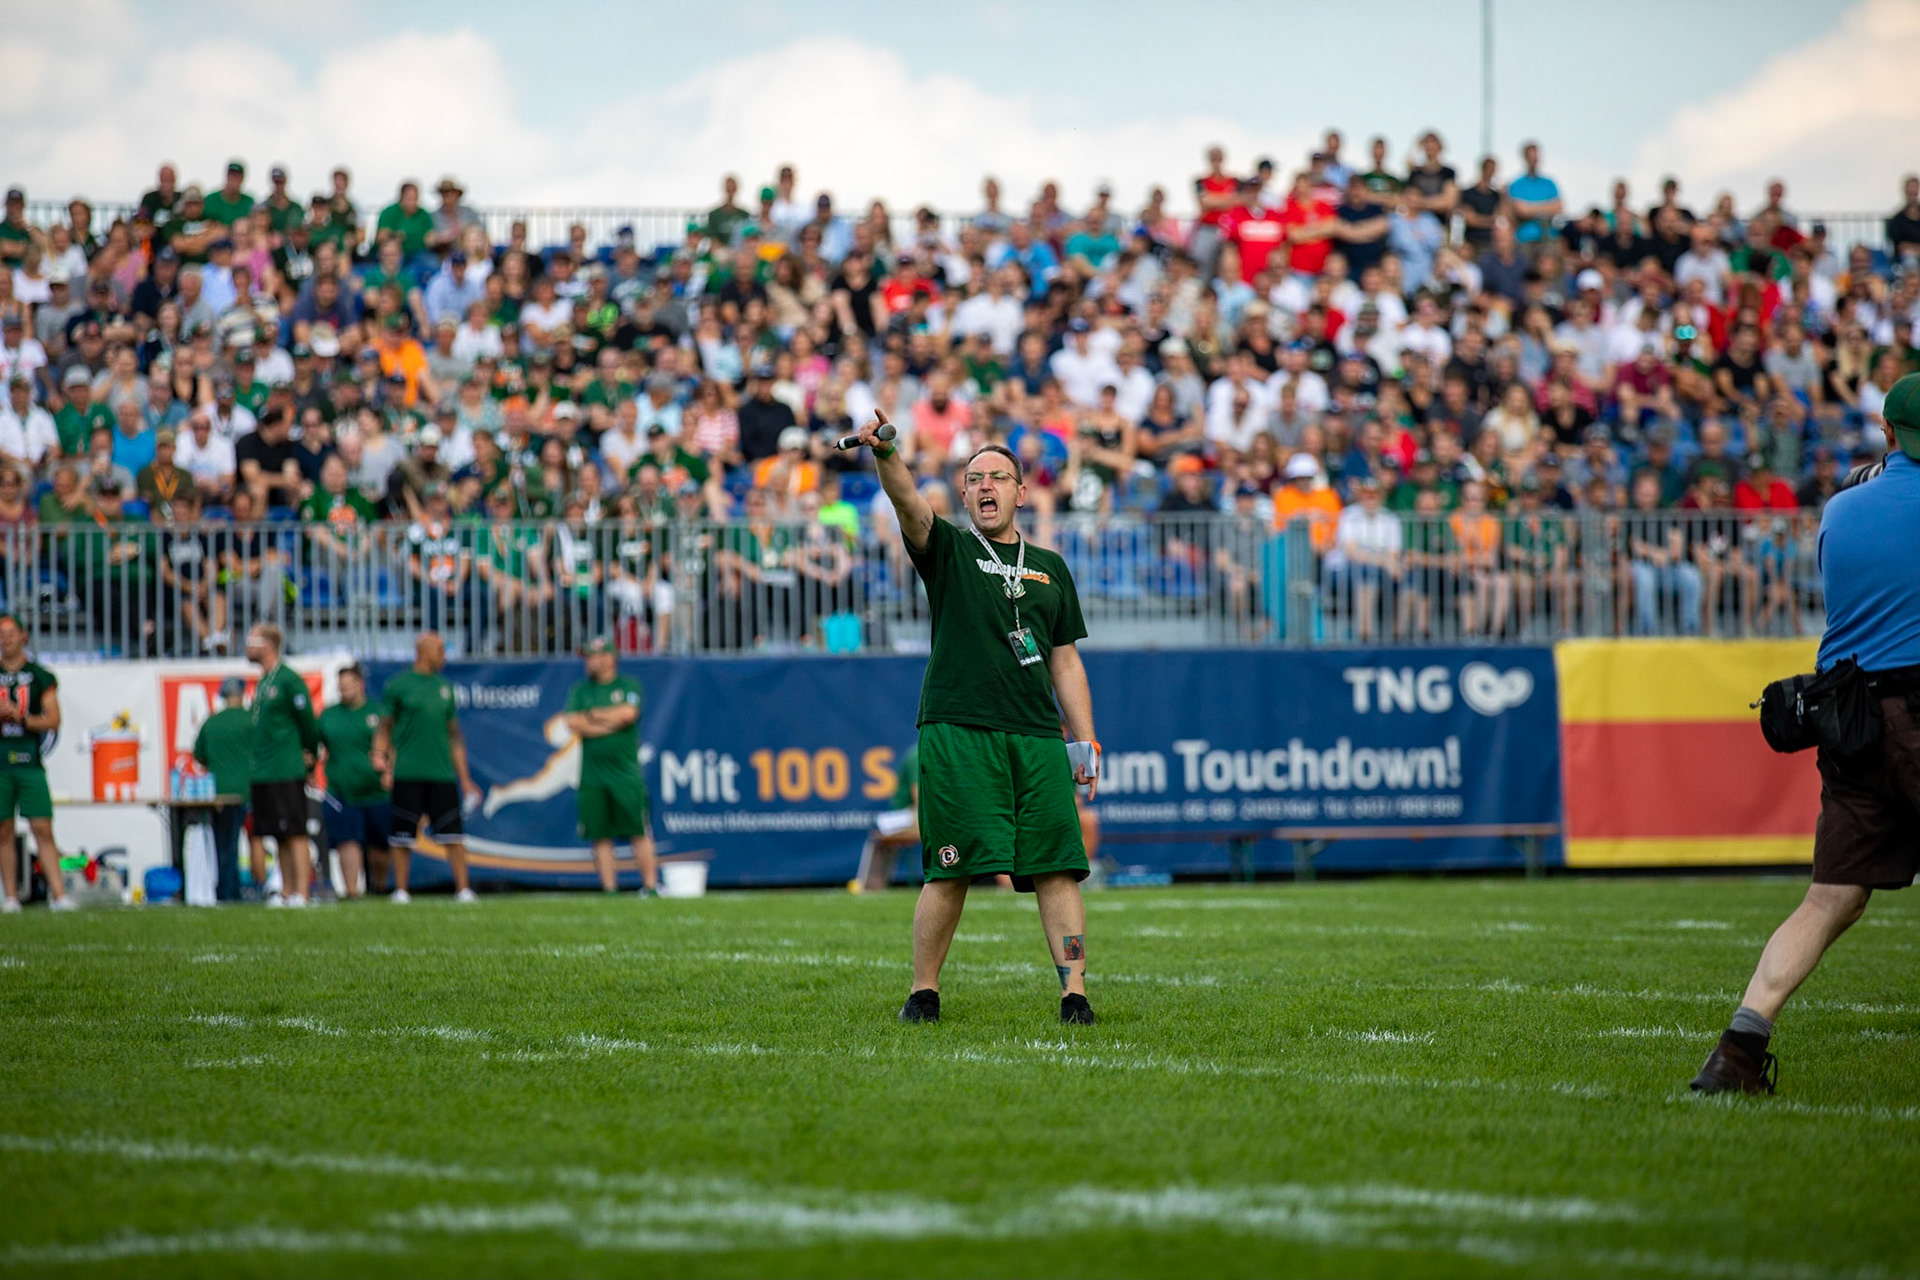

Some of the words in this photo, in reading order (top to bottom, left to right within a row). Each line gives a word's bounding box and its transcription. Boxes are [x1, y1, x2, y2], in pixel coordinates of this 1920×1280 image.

[471, 681, 543, 709] besser
[1343, 665, 1453, 714] TNG
[660, 749, 740, 804] Mit
[749, 747, 849, 801] 100
[862, 746, 899, 801] S
[1092, 751, 1167, 794] um
[1172, 736, 1461, 791] Touchdown!
